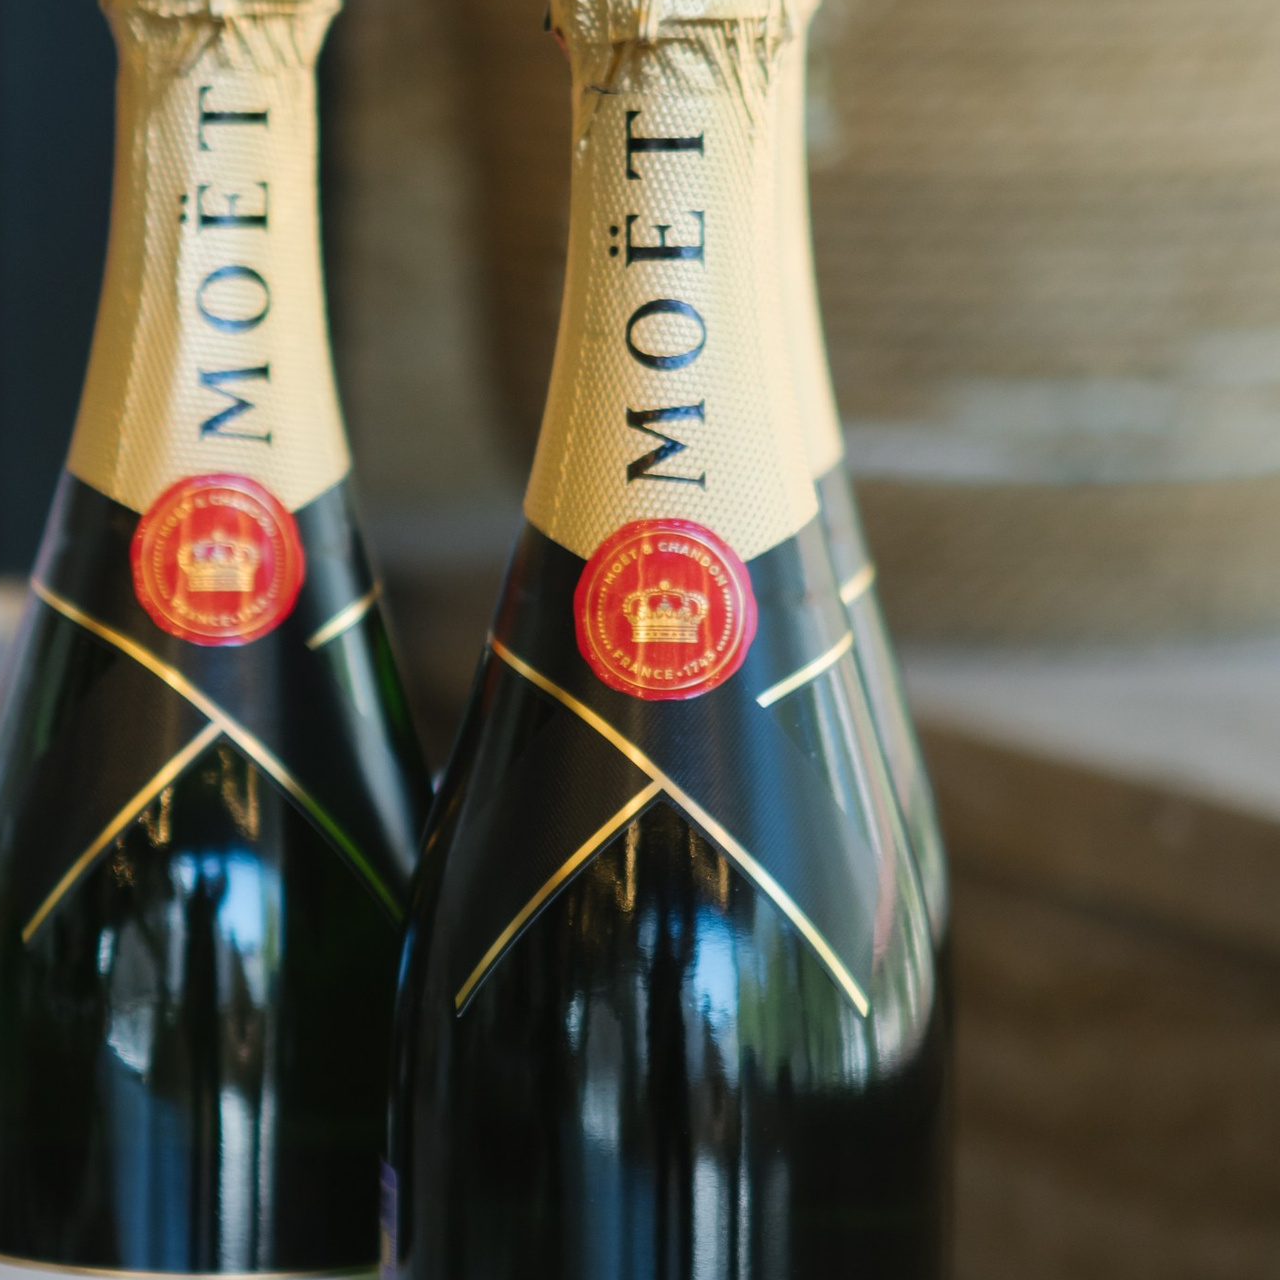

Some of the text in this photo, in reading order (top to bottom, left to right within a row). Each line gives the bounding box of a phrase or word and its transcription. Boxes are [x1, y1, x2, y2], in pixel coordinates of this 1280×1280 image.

[179, 84, 272, 446] MOËT
[609, 109, 708, 490] MOËT
[612, 648, 717, 680] FRANCE 1743
[657, 540, 729, 588] CHANDON
